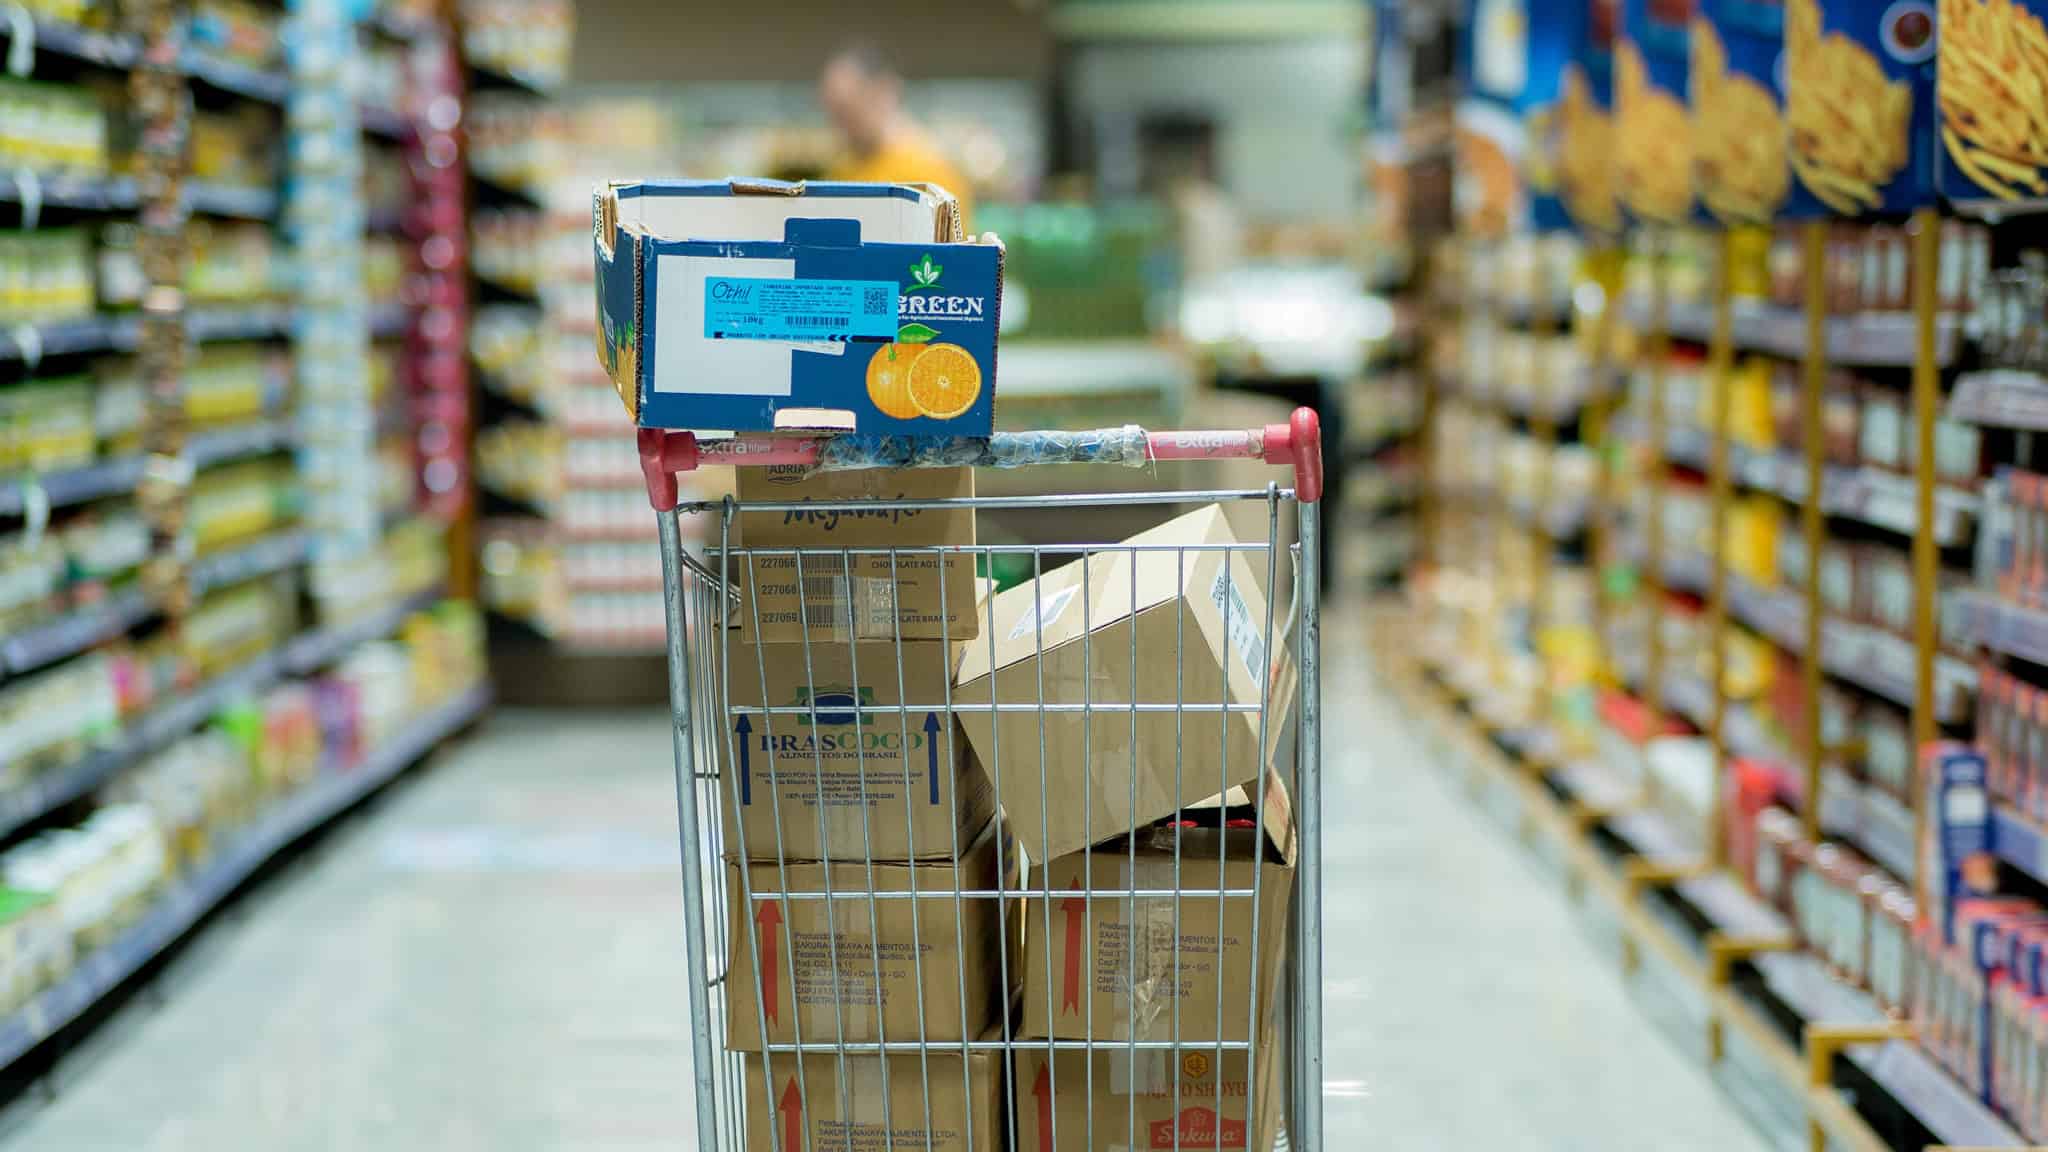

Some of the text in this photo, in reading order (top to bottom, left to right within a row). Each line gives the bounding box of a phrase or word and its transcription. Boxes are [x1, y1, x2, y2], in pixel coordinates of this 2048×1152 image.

[872, 560, 919, 569] CHOOLATE
[872, 614, 921, 625] CHOOLATE
[778, 751, 841, 760] ALIMETOS
